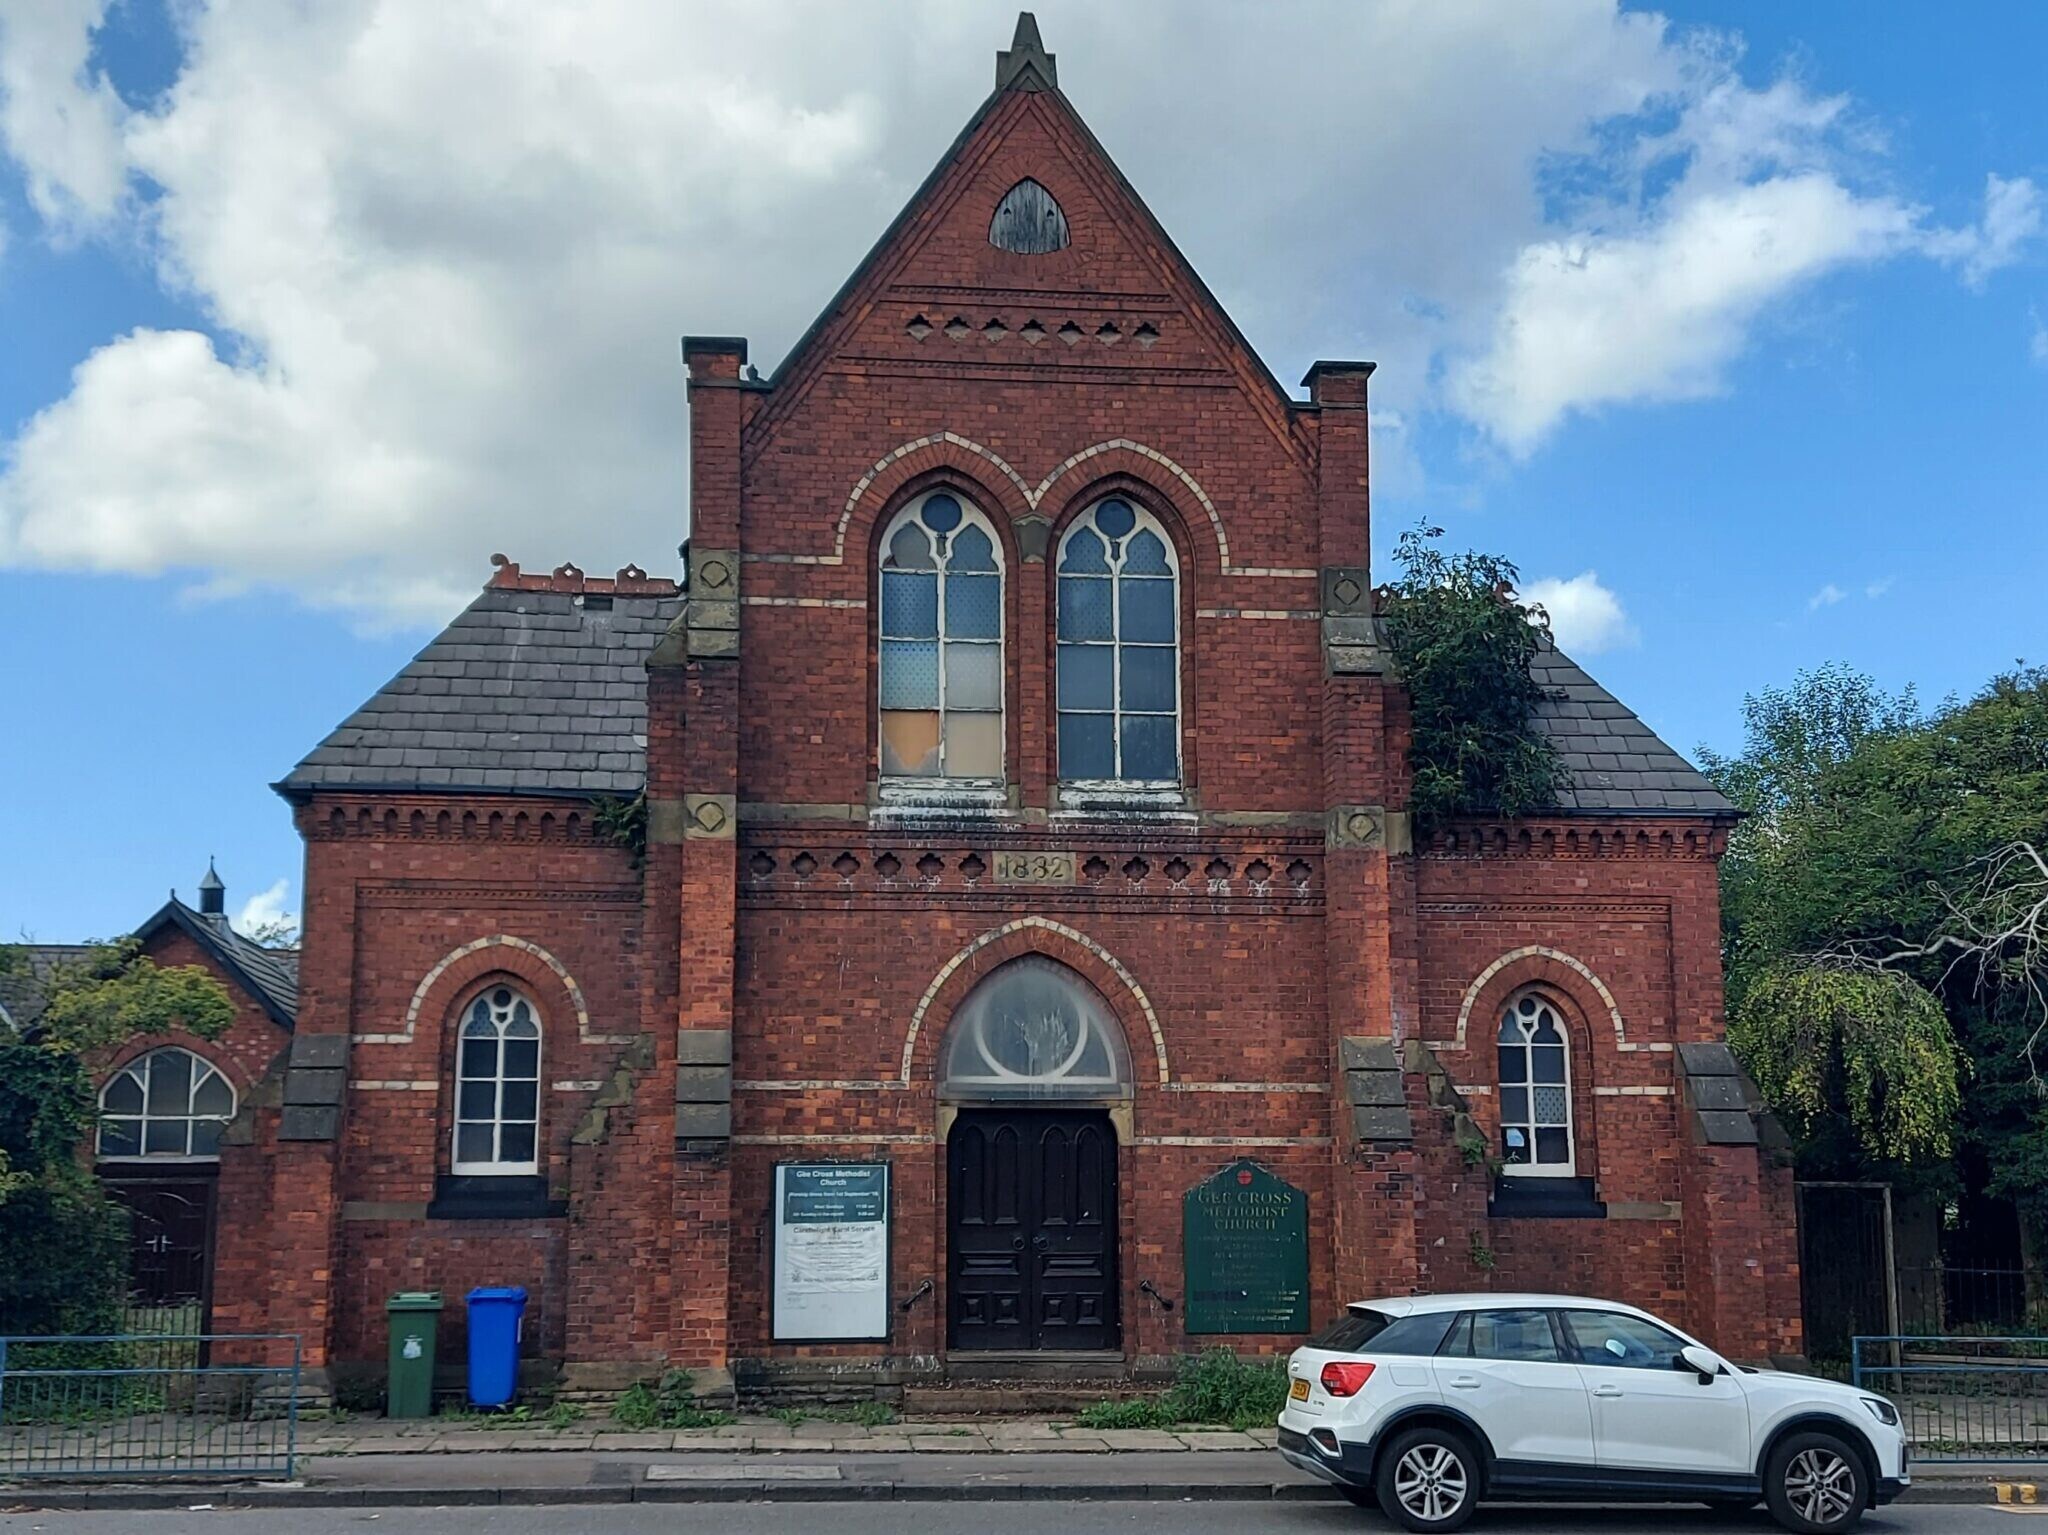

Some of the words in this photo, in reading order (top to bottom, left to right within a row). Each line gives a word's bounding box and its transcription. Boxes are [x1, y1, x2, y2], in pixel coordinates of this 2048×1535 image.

[812, 1170, 834, 1178] Cross
[835, 1170, 871, 1178] Methodist
[1237, 1191, 1292, 1204] CROSS
[1202, 1206, 1289, 1217] METHODIST
[1214, 1219, 1276, 1230] CHURCH
